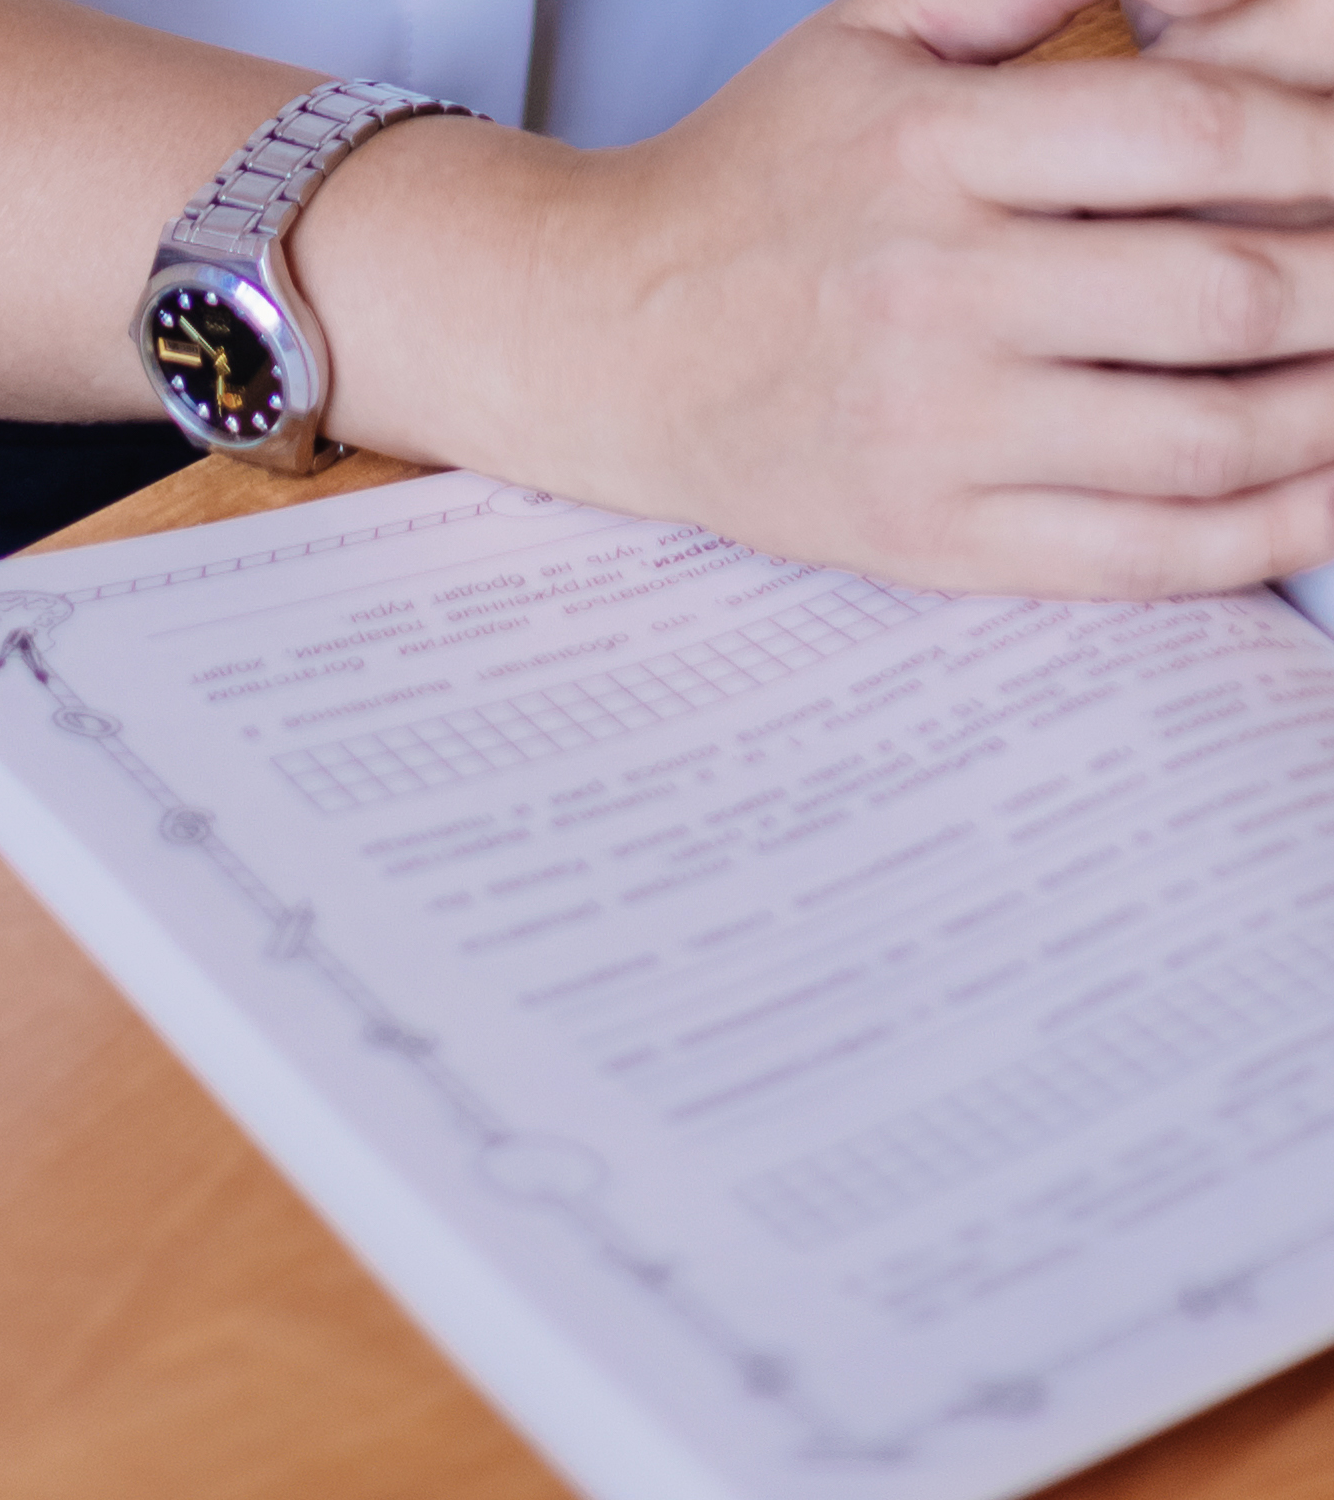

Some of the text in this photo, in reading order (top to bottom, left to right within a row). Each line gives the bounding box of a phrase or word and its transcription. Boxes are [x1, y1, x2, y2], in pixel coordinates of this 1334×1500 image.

[522, 491, 554, 507] 85
[539, 560, 574, 579] не
[586, 543, 644, 568] чуть
[340, 597, 416, 625] куры.
[431, 571, 527, 607] бродят
[444, 568, 624, 623] нагруженные
[285, 616, 425, 660] товарами,
[396, 613, 532, 657] недолгим
[650, 611, 698, 632] что
[941, 606, 1073, 676] достигает
[1110, 609, 1213, 645] Высота
[191, 655, 267, 686] ходят
[206, 655, 366, 703] богатством
[475, 631, 631, 683] обозначает
[847, 644, 947, 696] Какова
[998, 644, 1101, 696] берёзы
[280, 678, 453, 729] выделенное
[735, 696, 836, 744] высота
[820, 676, 924, 730] высоты
[927, 683, 1067, 754] Запишите
